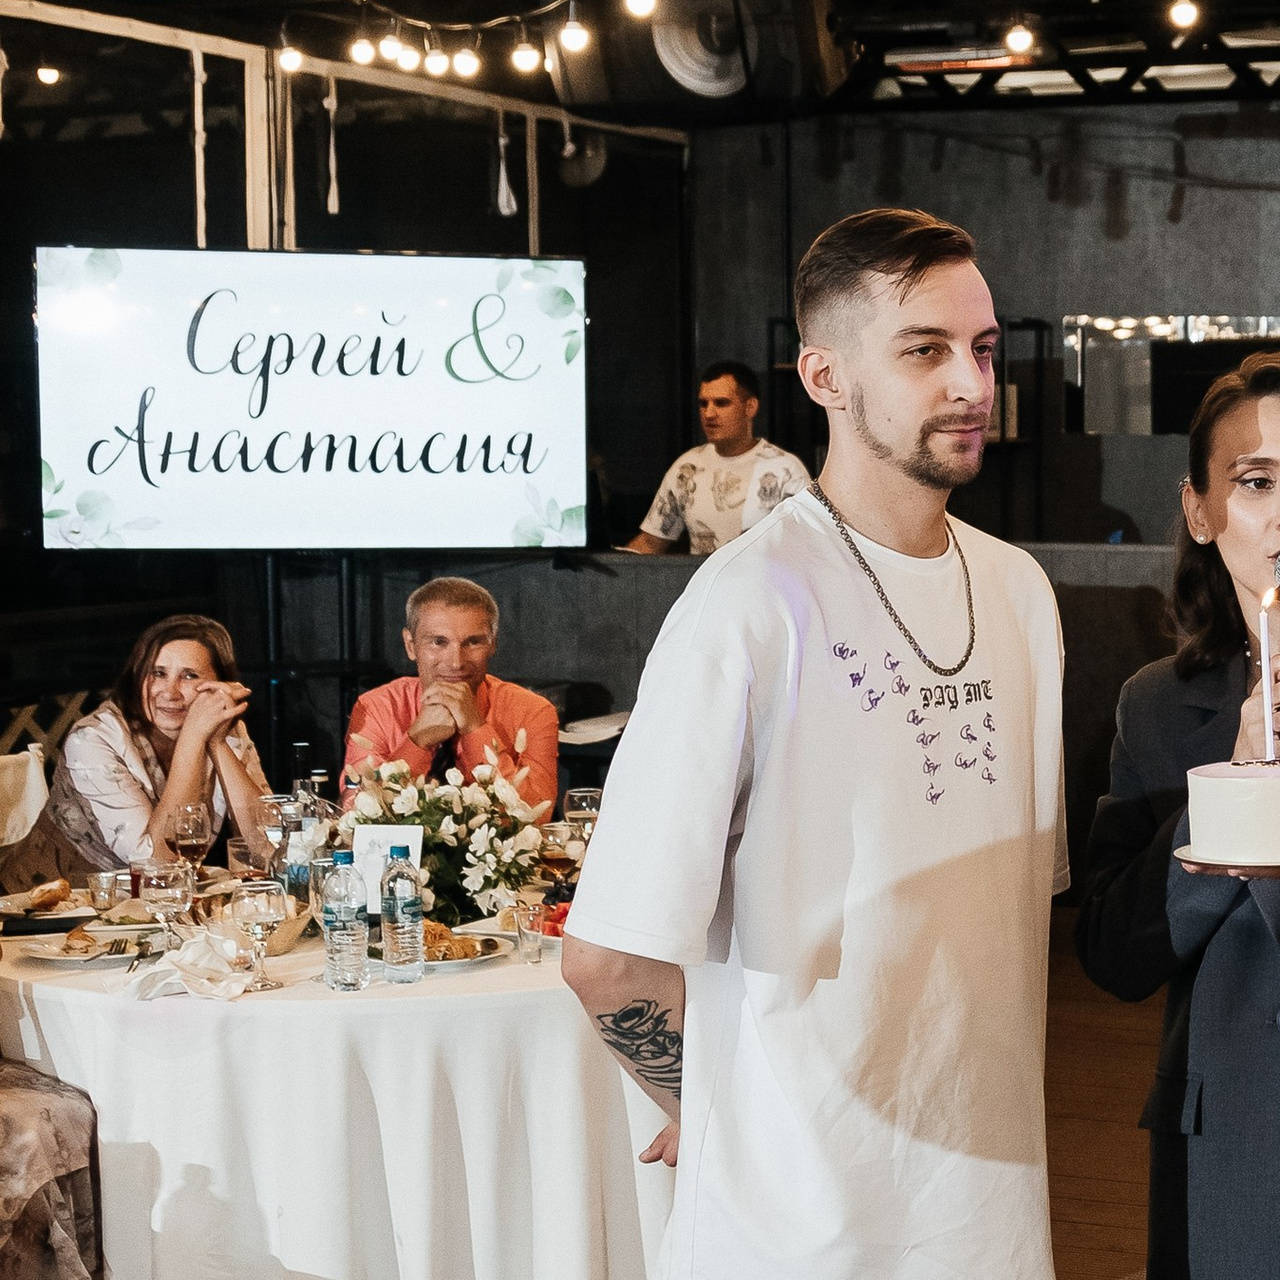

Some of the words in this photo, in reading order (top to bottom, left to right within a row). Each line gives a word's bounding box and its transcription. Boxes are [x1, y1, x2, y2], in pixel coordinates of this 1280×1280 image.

[187, 288, 423, 419] Сергей
[444, 293, 541, 383] &
[86, 386, 548, 488] Анастасия
[920, 684, 959, 713] PAY
[963, 679, 993, 705] ME
